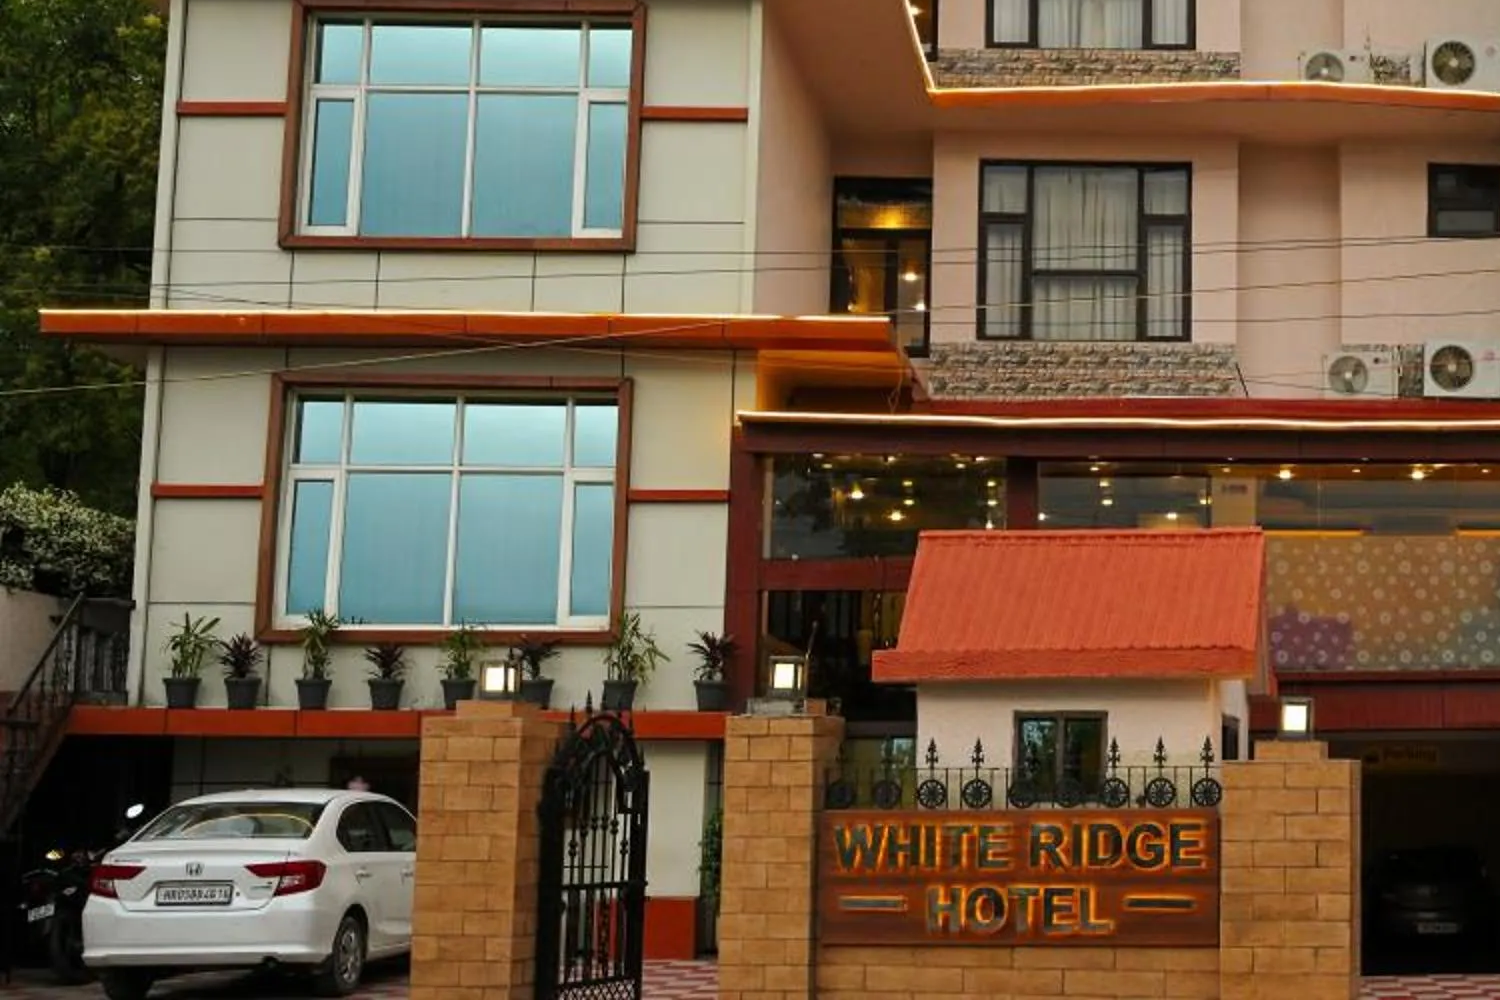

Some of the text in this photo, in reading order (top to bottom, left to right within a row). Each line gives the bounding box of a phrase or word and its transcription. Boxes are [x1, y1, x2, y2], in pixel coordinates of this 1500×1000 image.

[832, 819, 1209, 871] WHITE RIDGE
[925, 885, 1116, 935] HOTEL
